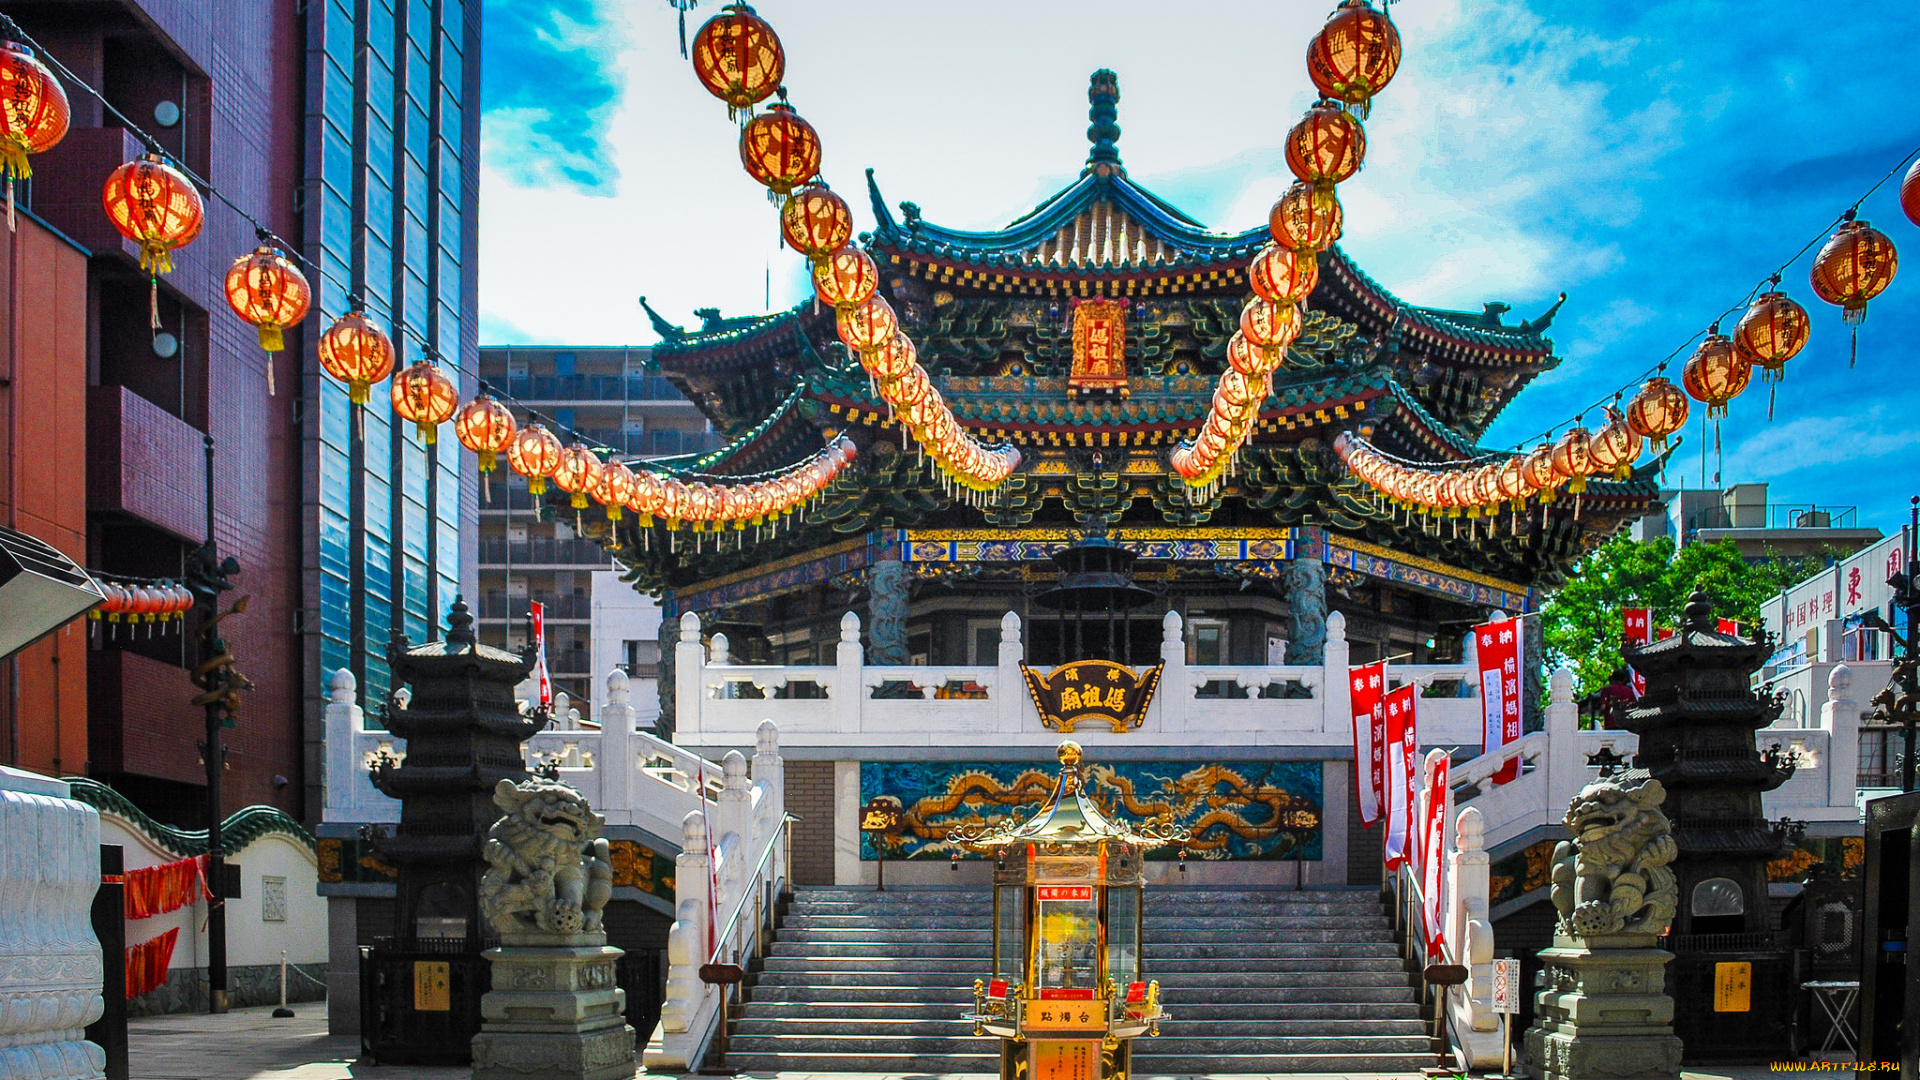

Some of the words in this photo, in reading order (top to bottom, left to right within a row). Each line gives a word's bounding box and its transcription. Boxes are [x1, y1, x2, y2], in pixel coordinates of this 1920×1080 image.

[1786, 590, 1833, 631] 中国料理
[1481, 629, 1513, 648] 奉納
[1353, 674, 1382, 692] 奉納
[1060, 683, 1126, 713] 媽祖廟
[1388, 696, 1412, 717] 奉納
